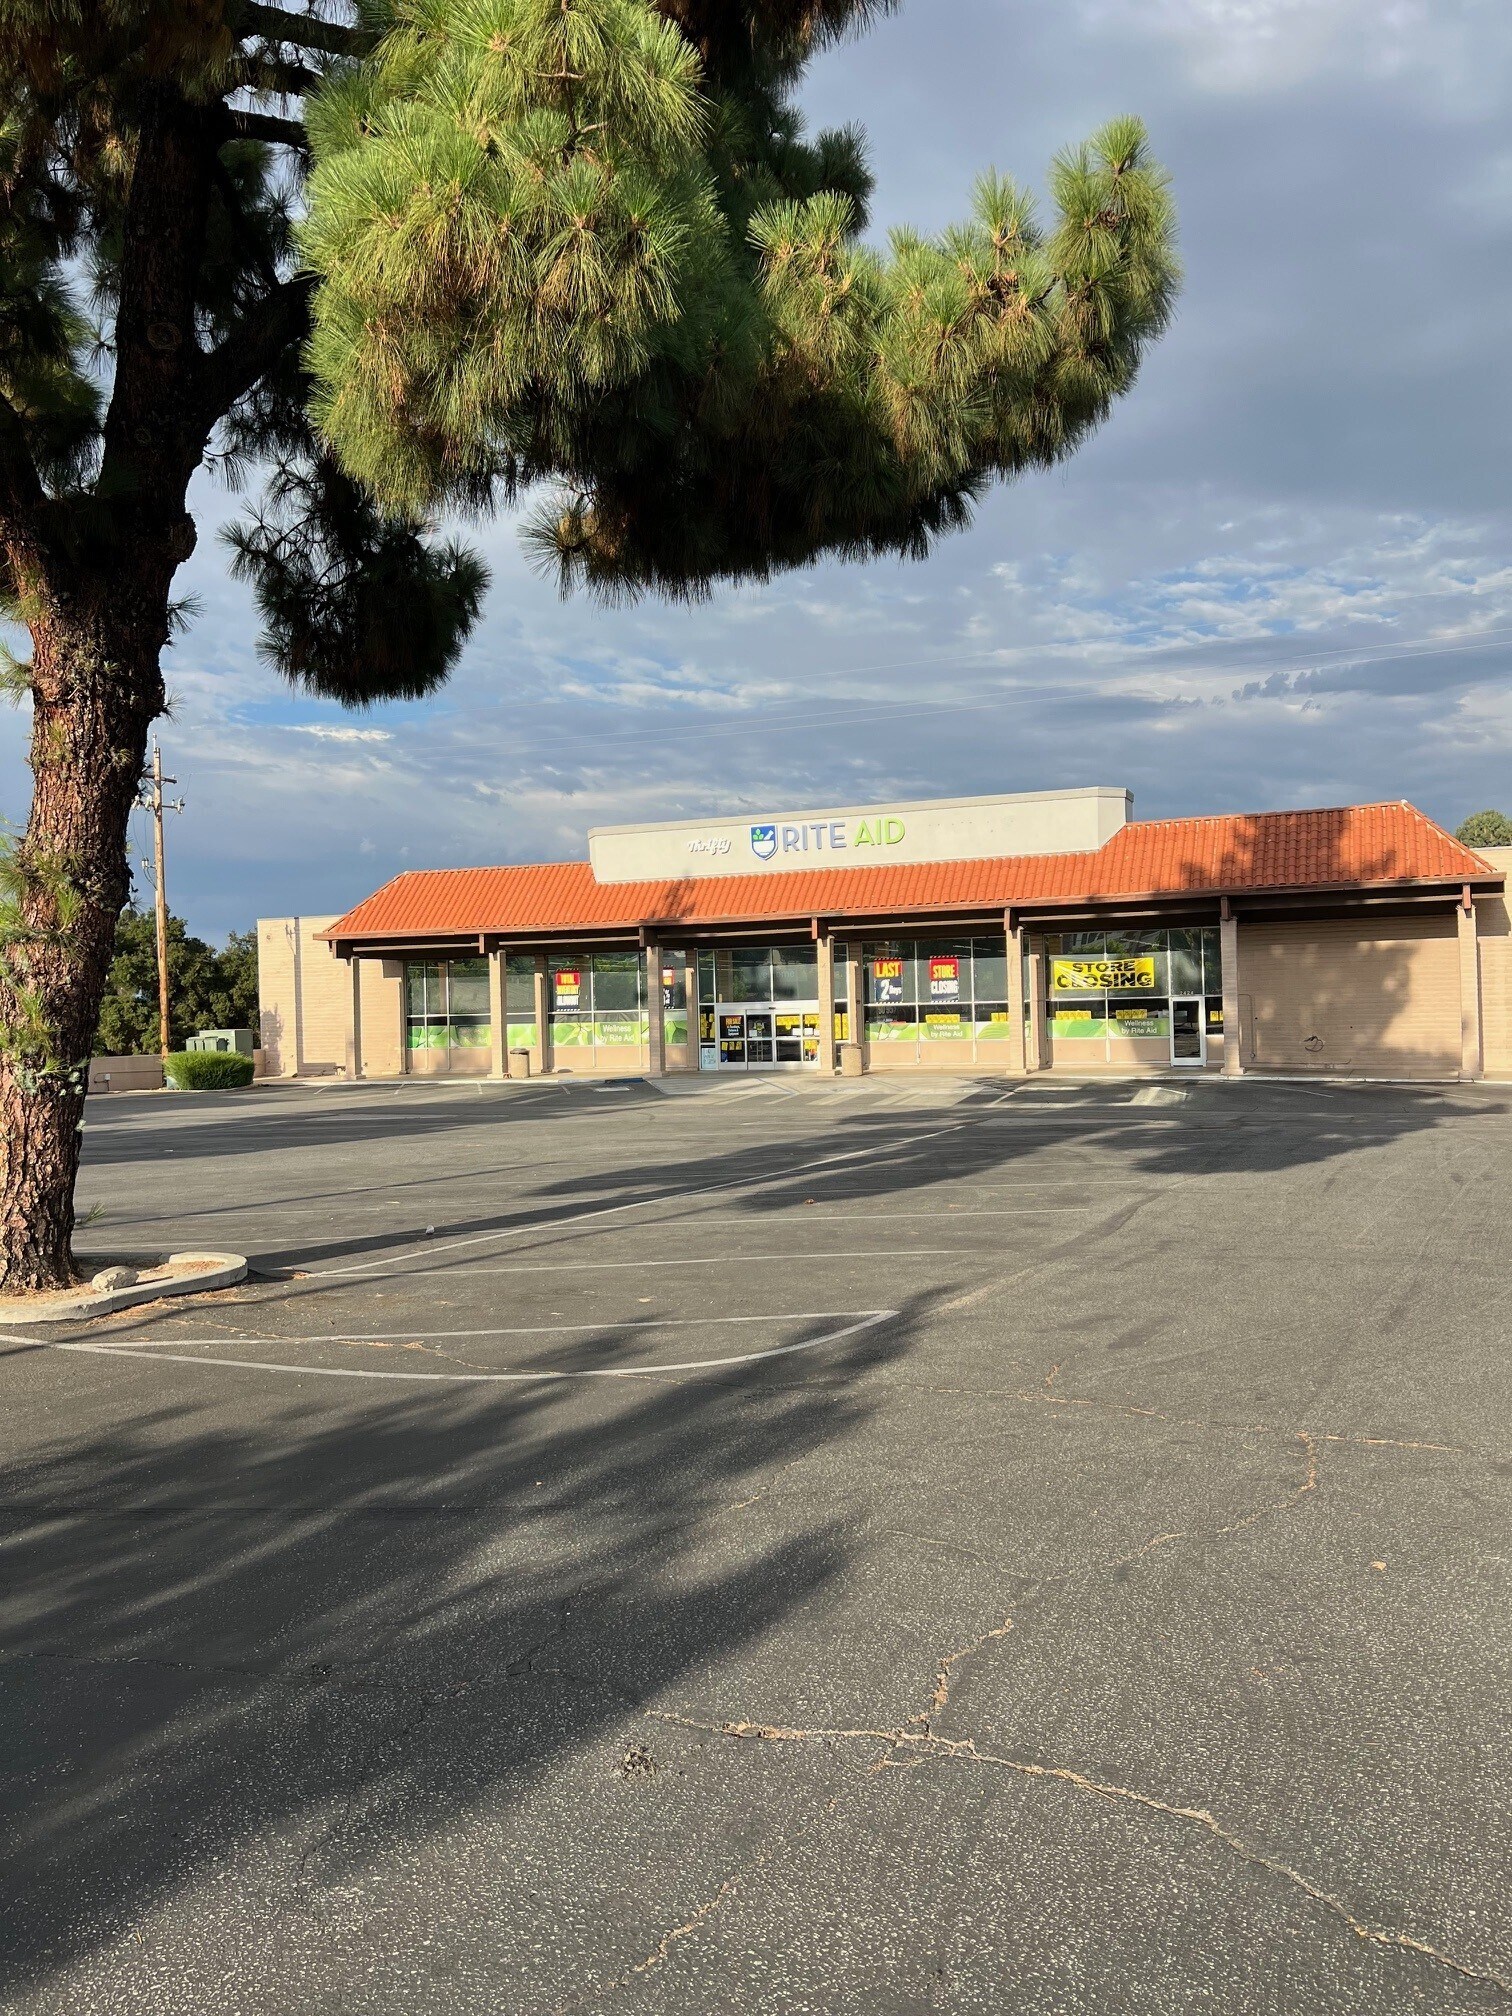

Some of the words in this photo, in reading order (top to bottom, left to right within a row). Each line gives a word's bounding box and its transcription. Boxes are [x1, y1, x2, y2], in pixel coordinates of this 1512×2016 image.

[782, 822, 847, 853] RITE
[855, 818, 906, 847] AID
[687, 838, 732, 856] Thrifty
[876, 962, 900, 979] LAST
[932, 964, 955, 979] STORE
[1072, 960, 1136, 973] STORE
[880, 979, 891, 1001] 2
[931, 980, 959, 995] CLOSING
[609, 1034, 622, 1042] Rite
[623, 1034, 634, 1042] Aid
[1121, 1027, 1130, 1035] by
